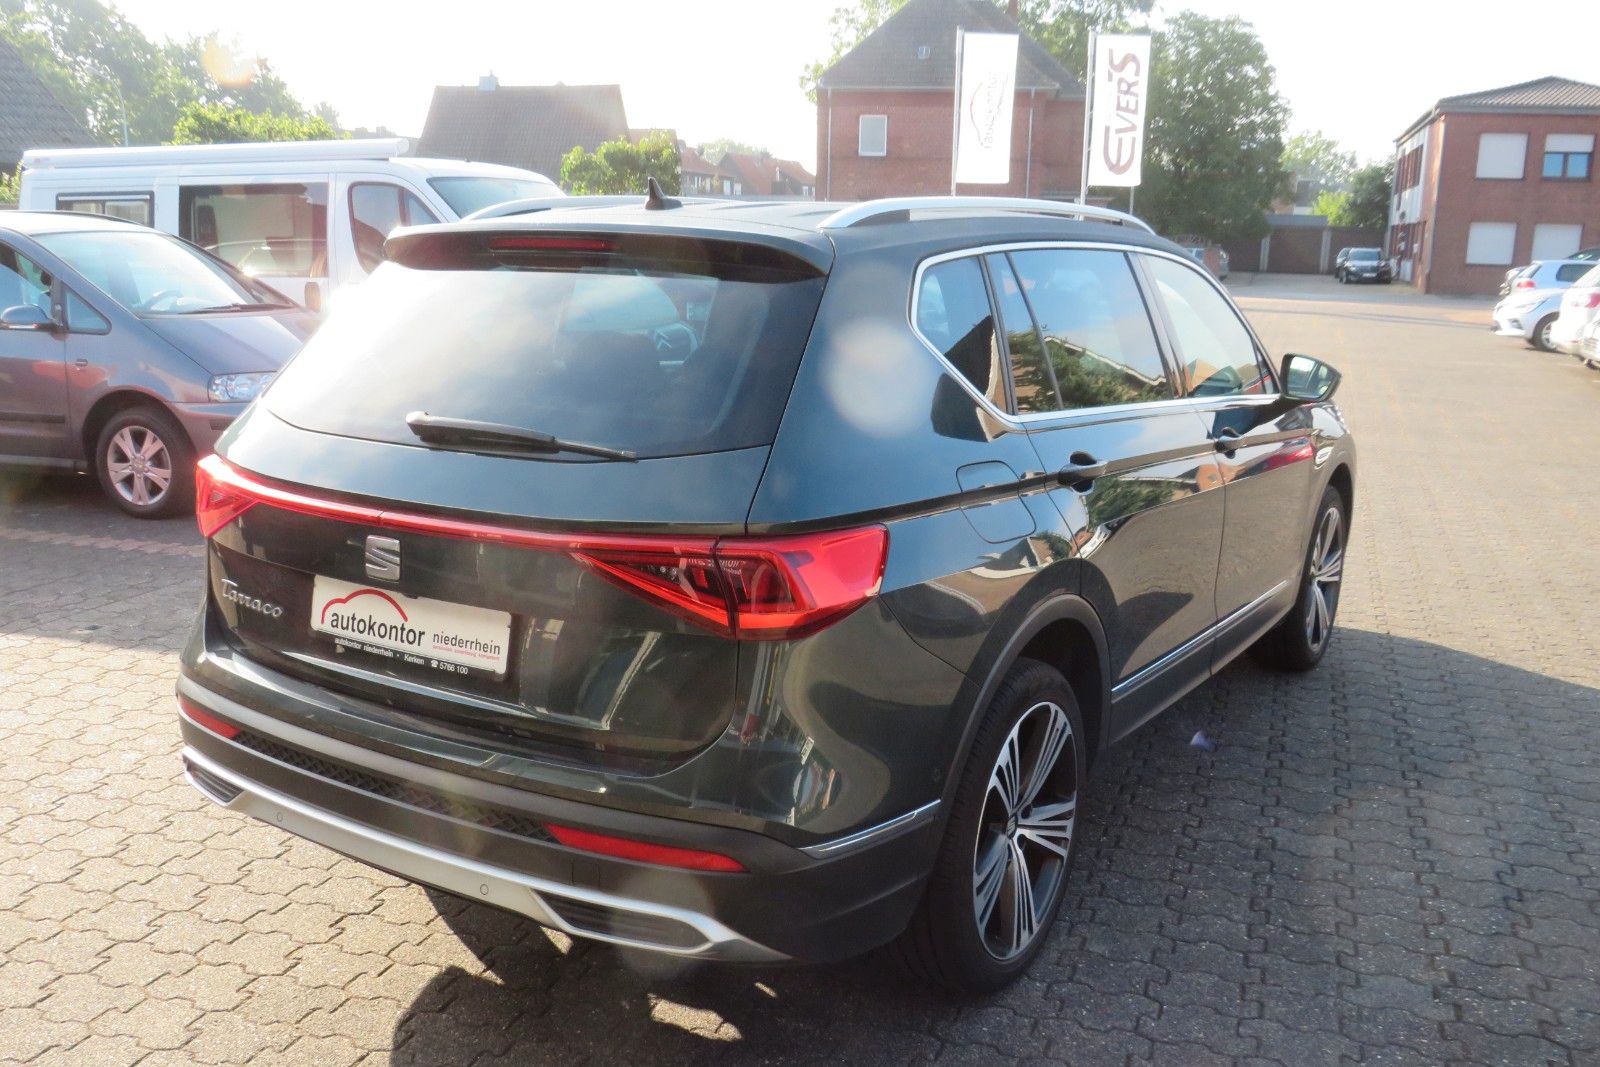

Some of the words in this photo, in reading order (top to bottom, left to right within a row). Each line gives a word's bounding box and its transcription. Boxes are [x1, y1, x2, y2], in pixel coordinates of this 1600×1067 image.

[221, 578, 283, 619] Tarraco
[330, 609, 426, 647] autokontor
[432, 631, 501, 656] niederrhein
[403, 653, 425, 665] Kerken
[439, 662, 456, 672] 5766
[456, 664, 469, 675] 100
